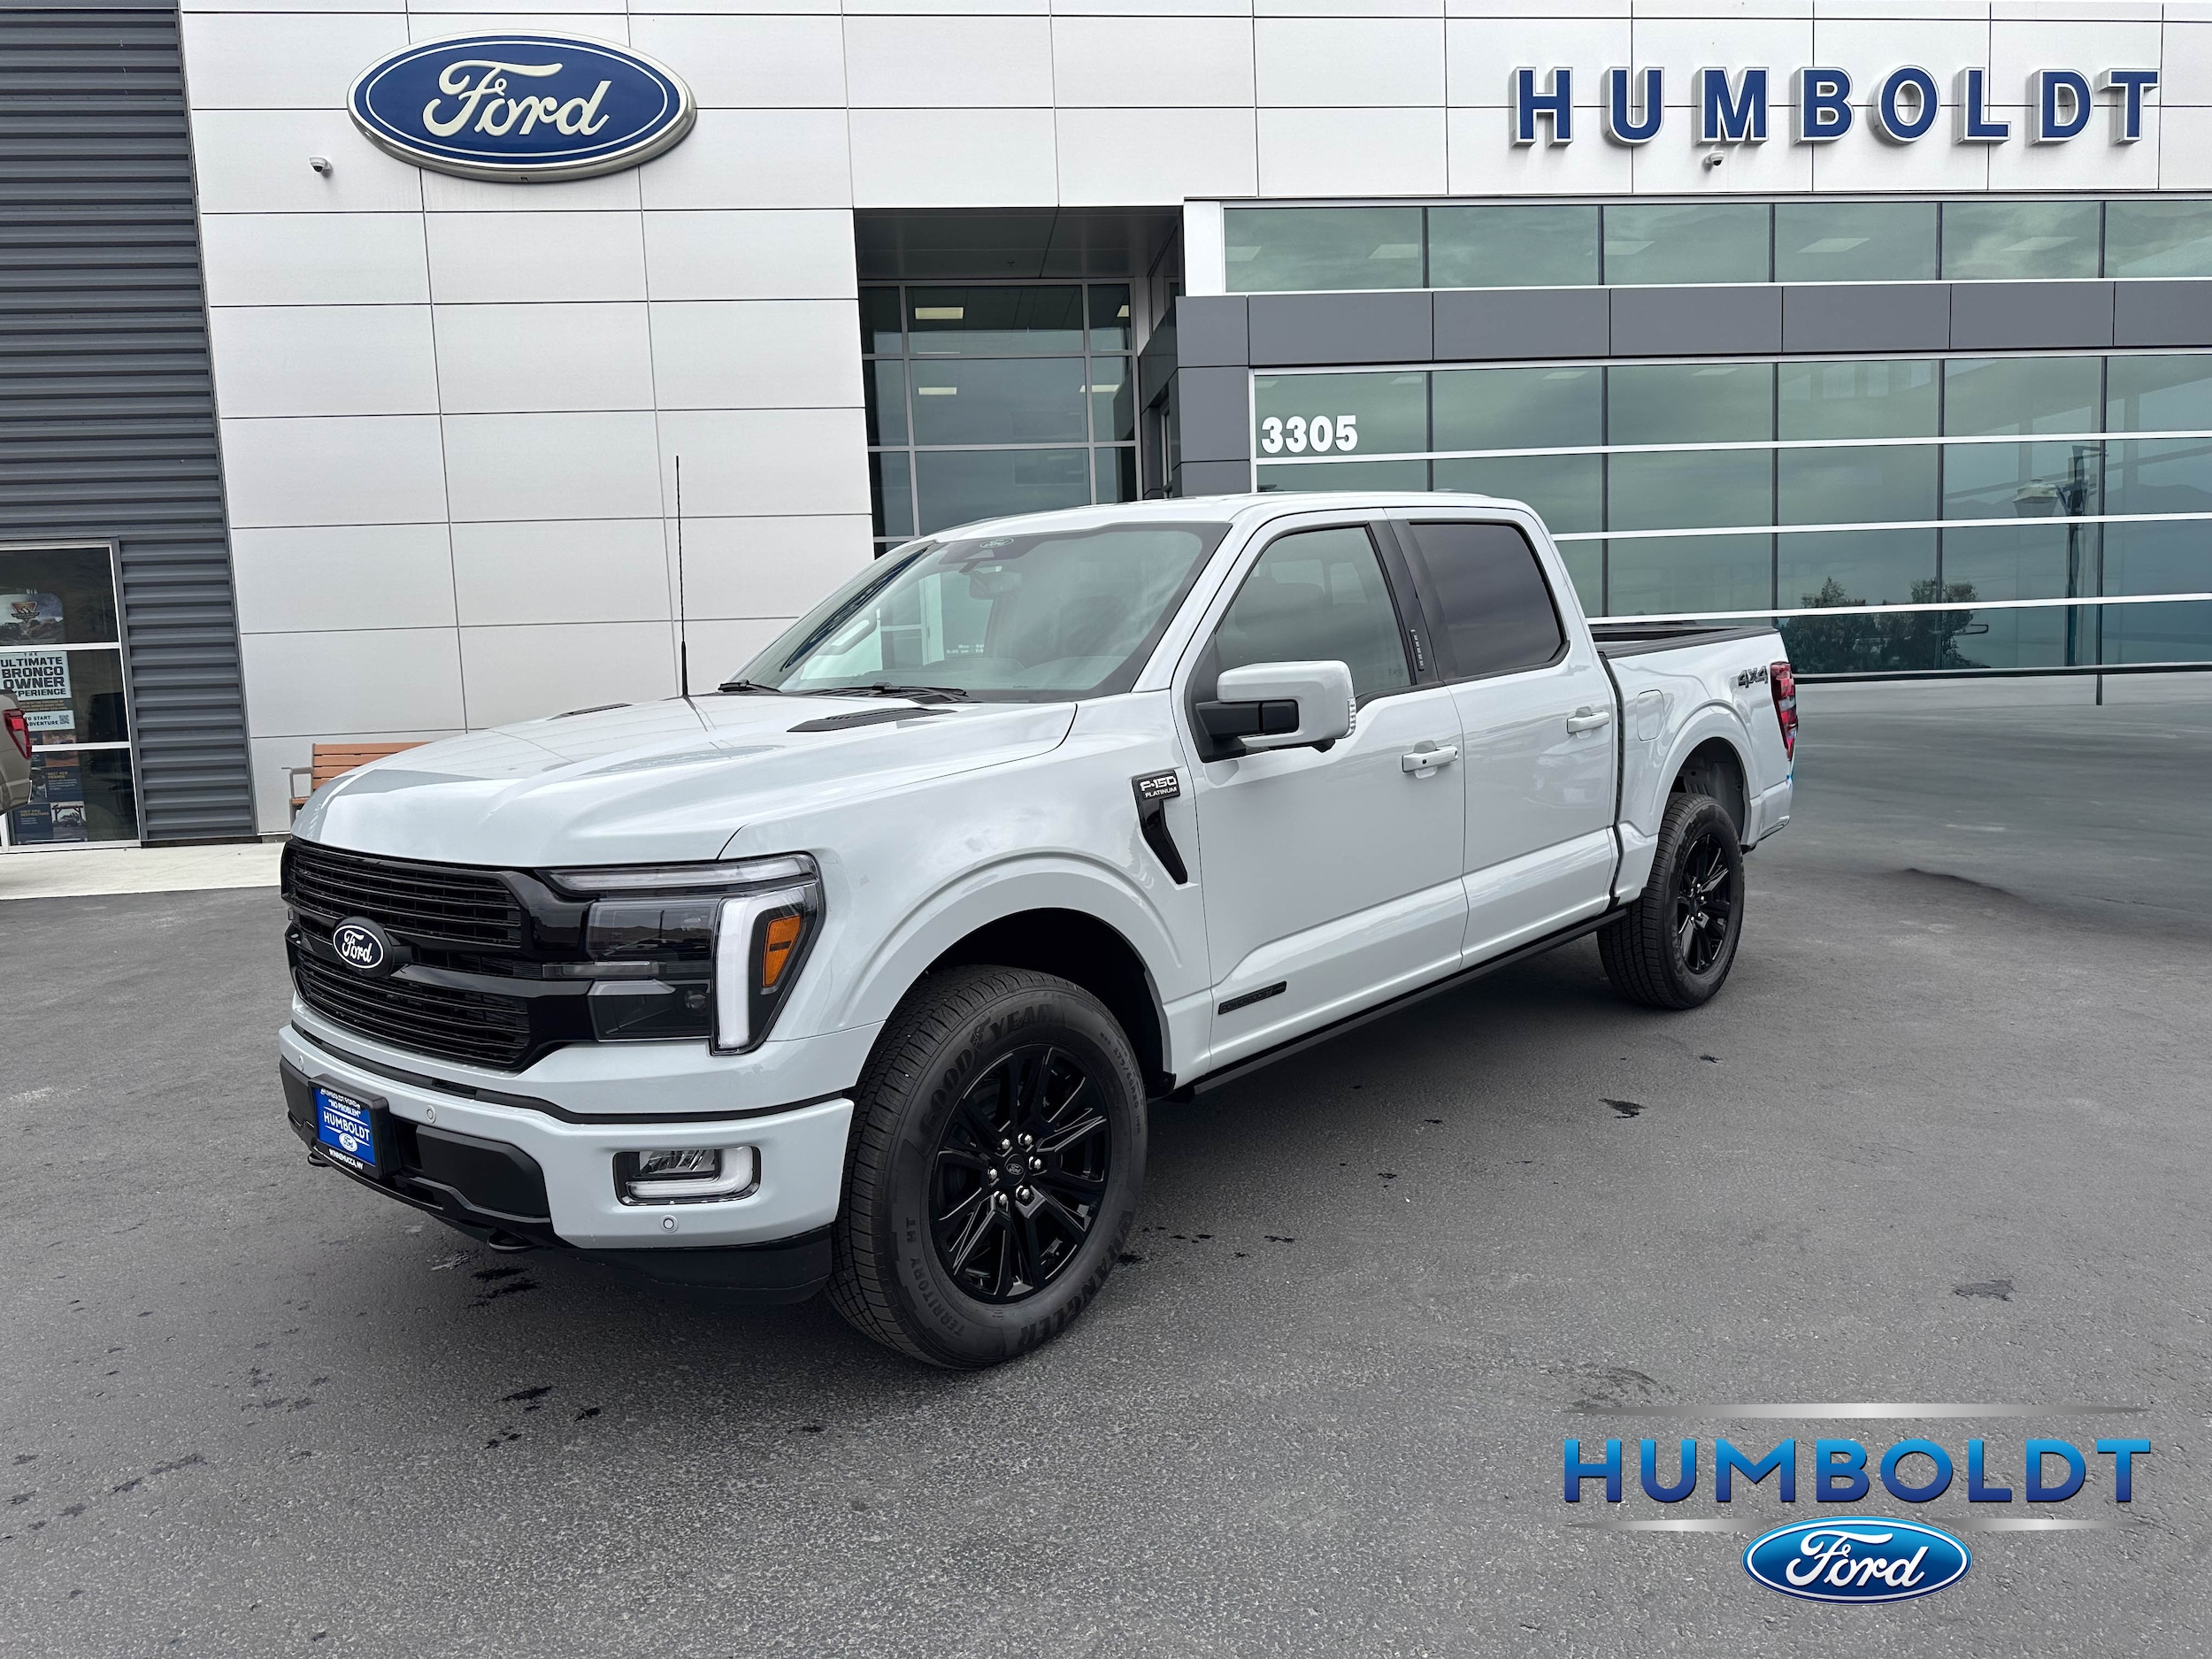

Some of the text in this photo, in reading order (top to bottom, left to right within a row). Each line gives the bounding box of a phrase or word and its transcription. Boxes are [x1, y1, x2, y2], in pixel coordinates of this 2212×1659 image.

[423, 60, 612, 137] Ford
[1510, 65, 2161, 148] HUMBOLDT
[1261, 415, 1358, 454] 3305
[0, 657, 63, 668] ULTIMATE
[2, 666, 64, 679] BRONCO
[4, 677, 65, 689] OWNER
[15, 688, 66, 697] PERIENCE
[1140, 775, 1178, 792] F-150
[1145, 786, 1178, 798] PLATINUM
[342, 930, 373, 963] Ford
[1221, 988, 1273, 1012] POWERBOOST
[323, 1110, 371, 1141] HUMBOLDT
[910, 1257, 965, 1337] TERRITORY
